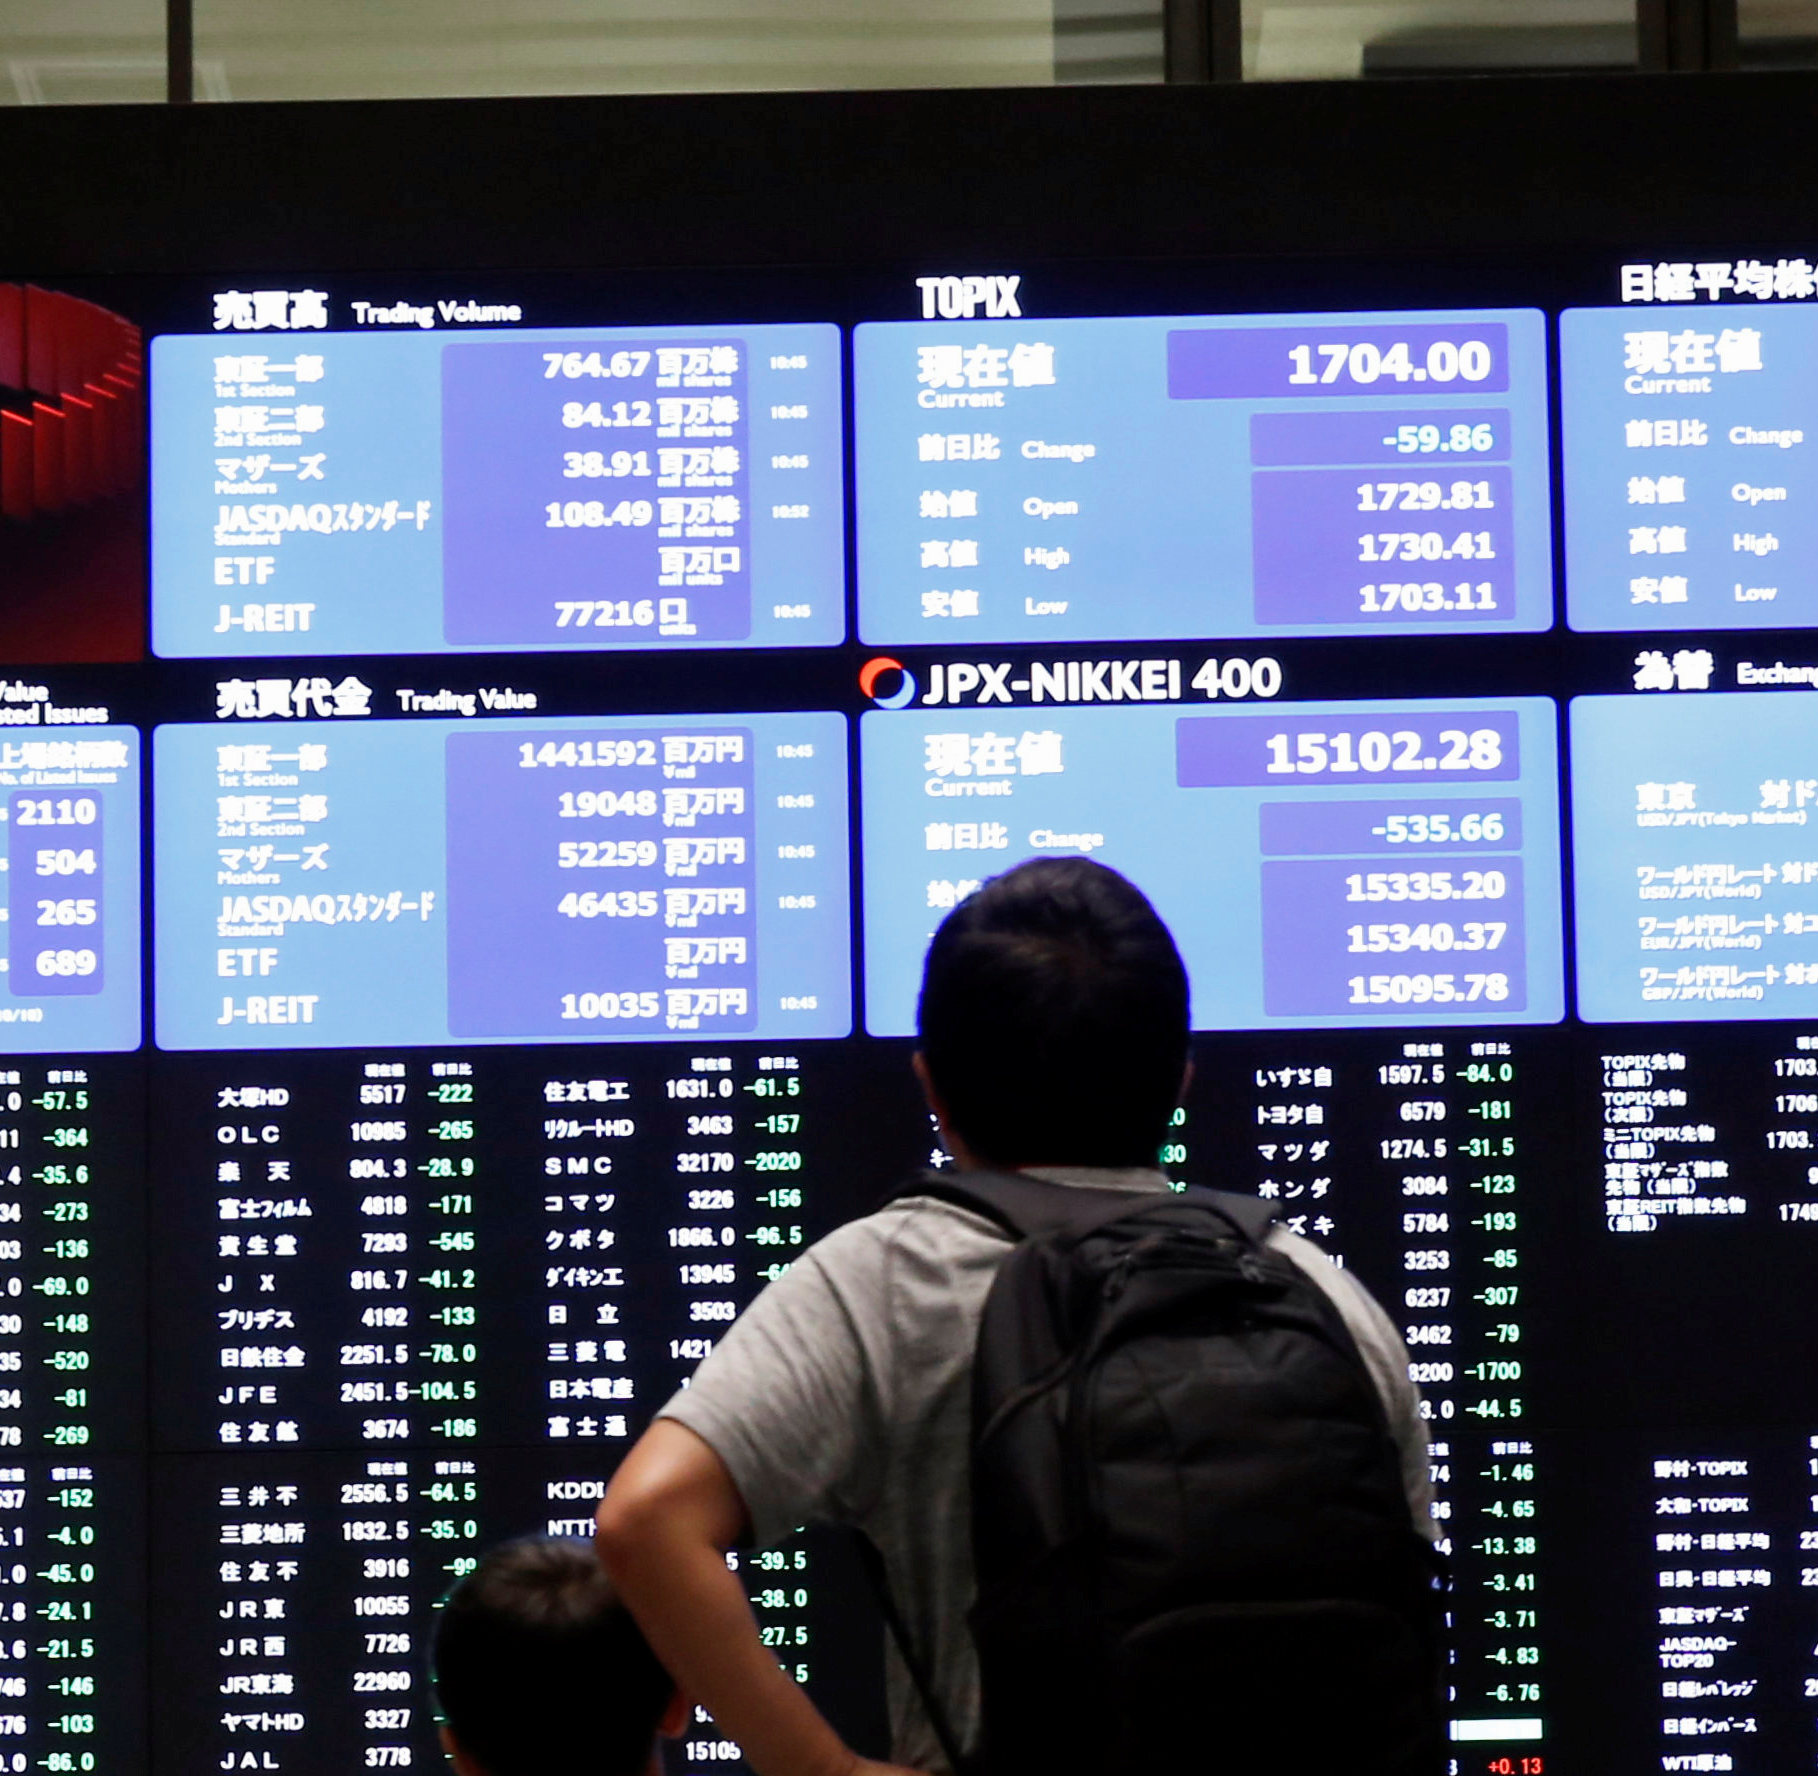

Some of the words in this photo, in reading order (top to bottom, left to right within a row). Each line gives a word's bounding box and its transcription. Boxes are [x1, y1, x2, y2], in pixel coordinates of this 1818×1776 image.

[213, 290, 328, 330] 売買高
[352, 302, 434, 328] Trading
[438, 301, 521, 322] Volume
[916, 276, 1021, 318] TOPIX
[214, 355, 324, 386] 東証一部
[543, 352, 650, 378] 764.67
[656, 346, 738, 378] 百万株
[917, 343, 1055, 388] 現在値
[1289, 341, 1490, 383] 1704.00
[1624, 328, 1762, 374] 現在値
[918, 389, 1004, 408] Current
[1625, 375, 1711, 394] Current
[214, 405, 324, 436] 東証二部
[562, 401, 651, 428] 84.12
[1625, 419, 1708, 447] 前日比
[1729, 427, 1803, 448] Change
[918, 434, 1000, 461] 前日比
[1021, 441, 1095, 462] Change
[1383, 424, 1493, 453] -59.86
[215, 453, 326, 481] マザーズ
[564, 451, 651, 477] 38.91
[1023, 498, 1078, 519] Open
[1357, 481, 1494, 510] 1729.81
[1732, 484, 1786, 505] Open
[214, 501, 430, 537] JASDAQスタンダード
[546, 501, 652, 527] 108.49
[921, 540, 978, 568] 高値
[1025, 547, 1069, 569] High
[1359, 532, 1495, 561] 1730.41
[1629, 526, 1686, 554] 高値
[1734, 533, 1778, 555] High
[215, 557, 274, 585] ETF
[922, 590, 979, 617] 安値
[1026, 598, 1068, 615] Low
[1360, 583, 1496, 611] 1703.11
[1631, 576, 1688, 603] 安値
[1735, 584, 1777, 601] Low
[214, 604, 315, 632] J-REIT
[555, 600, 654, 627] 77216
[922, 660, 1180, 704] JPX-NIKKEI
[1192, 658, 1281, 698] 400
[1633, 650, 1714, 690] 為替
[216, 677, 372, 718] 売買代金
[396, 689, 476, 716] Trading
[479, 688, 536, 709] Value
[45, 703, 108, 724] Issues
[217, 744, 327, 775] 東証一部
[520, 740, 656, 767] 1441592
[662, 736, 743, 763] 百万円
[925, 731, 1064, 776] 現在値
[1267, 730, 1501, 773] 15102.28
[925, 778, 1012, 796] Current
[1636, 782, 1695, 811] 東京
[17, 799, 95, 825] 2110
[217, 794, 327, 825] 東証二部
[559, 790, 657, 817] 19048
[925, 823, 1008, 850] 前日比
[1029, 830, 1103, 851] Change
[1372, 813, 1503, 842] -535.66
[36, 849, 96, 875] 504
[218, 843, 329, 871] マザーズ
[559, 841, 657, 867] 52259
[1346, 871, 1505, 901] 15335.20
[1637, 864, 1777, 887] ワールド円レート
[37, 899, 96, 925] 265
[217, 891, 434, 928] JASDAQスタンダード
[558, 891, 658, 917] 46435
[1348, 923, 1506, 952] 15340.37
[1639, 914, 1778, 938] ワールド円レート
[37, 950, 96, 976] 689
[218, 948, 277, 976] ETF
[1640, 963, 1779, 985] ワールド円レート
[1349, 973, 1508, 1003] 15095.78
[218, 996, 318, 1024] J-REIT
[562, 992, 659, 1018] 10035
[1258, 1104, 1323, 1124] トヨタ自
[1400, 1102, 1445, 1121] 6579
[1469, 1101, 1510, 1119] -181
[44, 1351, 89, 1369] -520
[48, 1489, 93, 1507] -152
[220, 1673, 293, 1694] JR東海
[354, 1671, 410, 1691] 22960
[48, 1715, 93, 1733] -103
